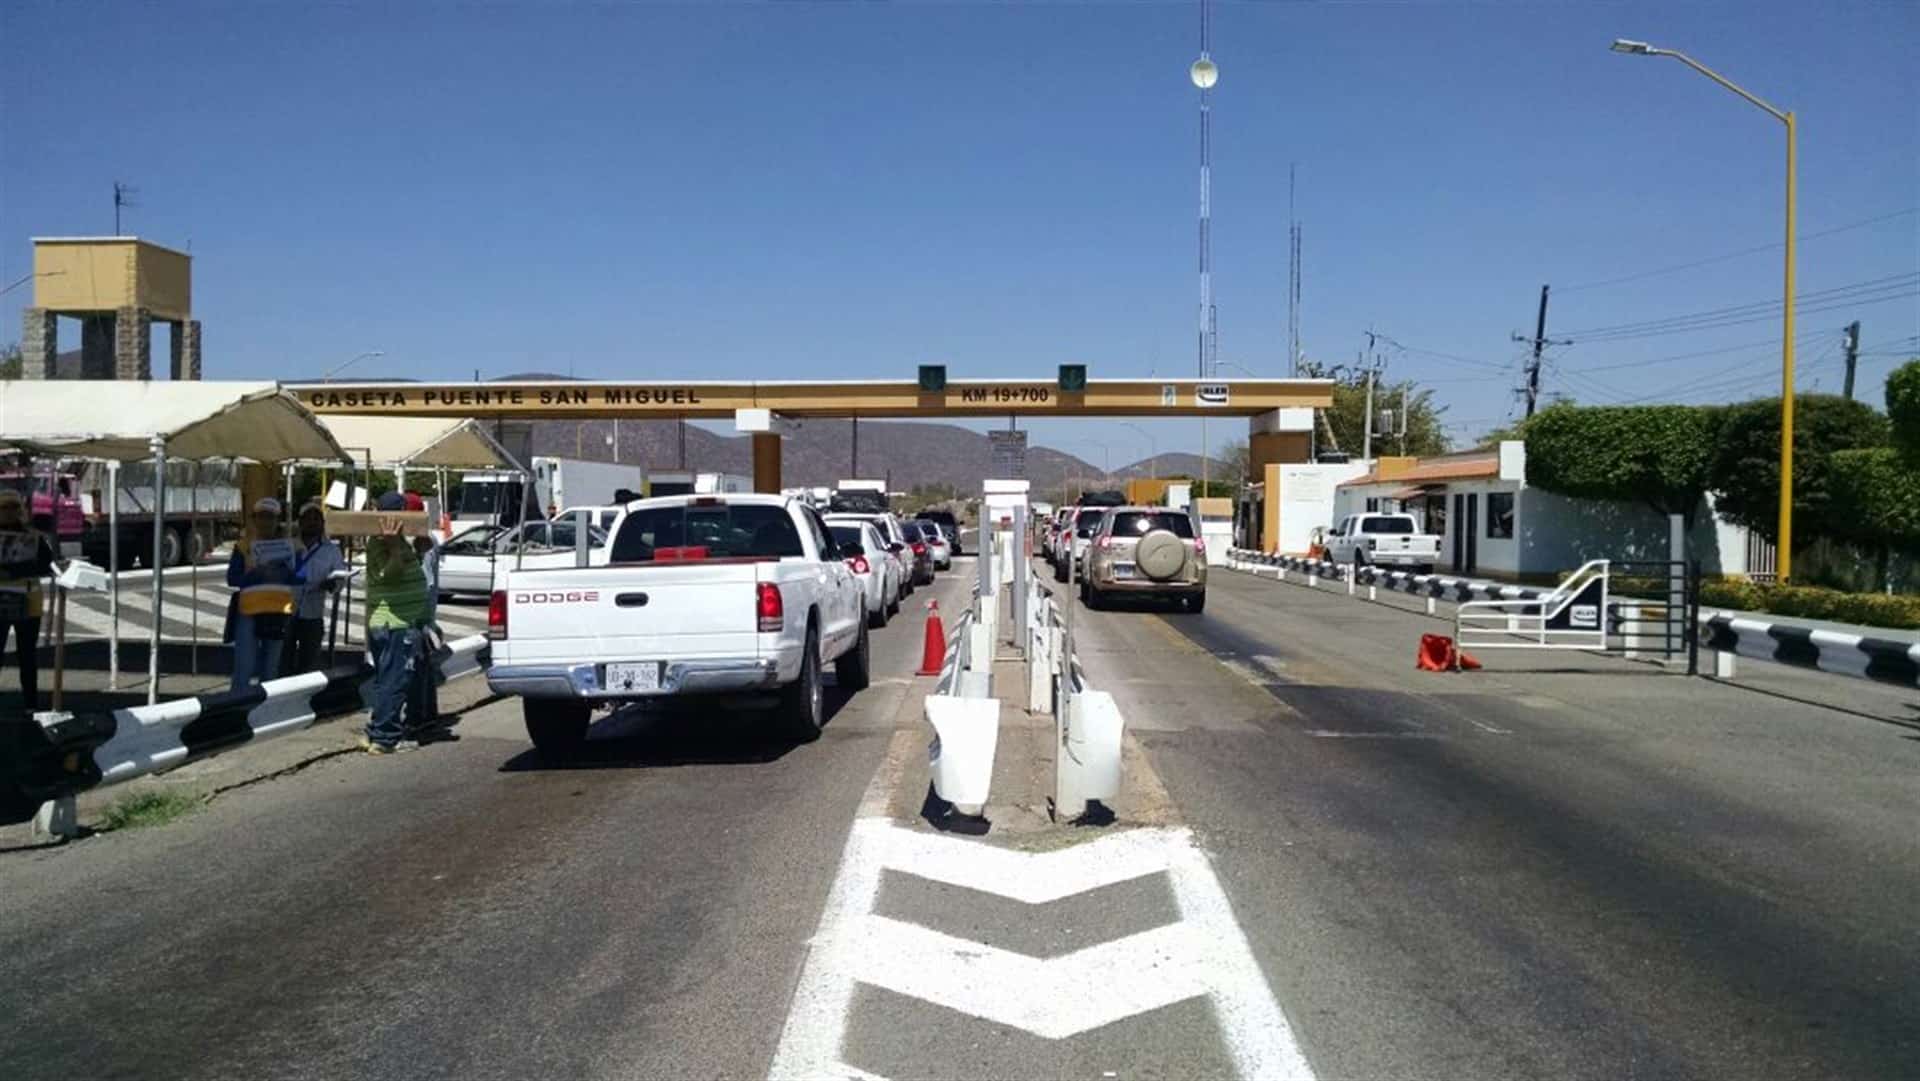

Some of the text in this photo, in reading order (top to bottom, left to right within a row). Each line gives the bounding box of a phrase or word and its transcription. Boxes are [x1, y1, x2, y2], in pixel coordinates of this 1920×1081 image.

[311, 389, 701, 407] CASETA PUENTE SAN MIGUEL
[962, 387, 1049, 402] KM 19+700
[515, 591, 599, 604] DODGE
